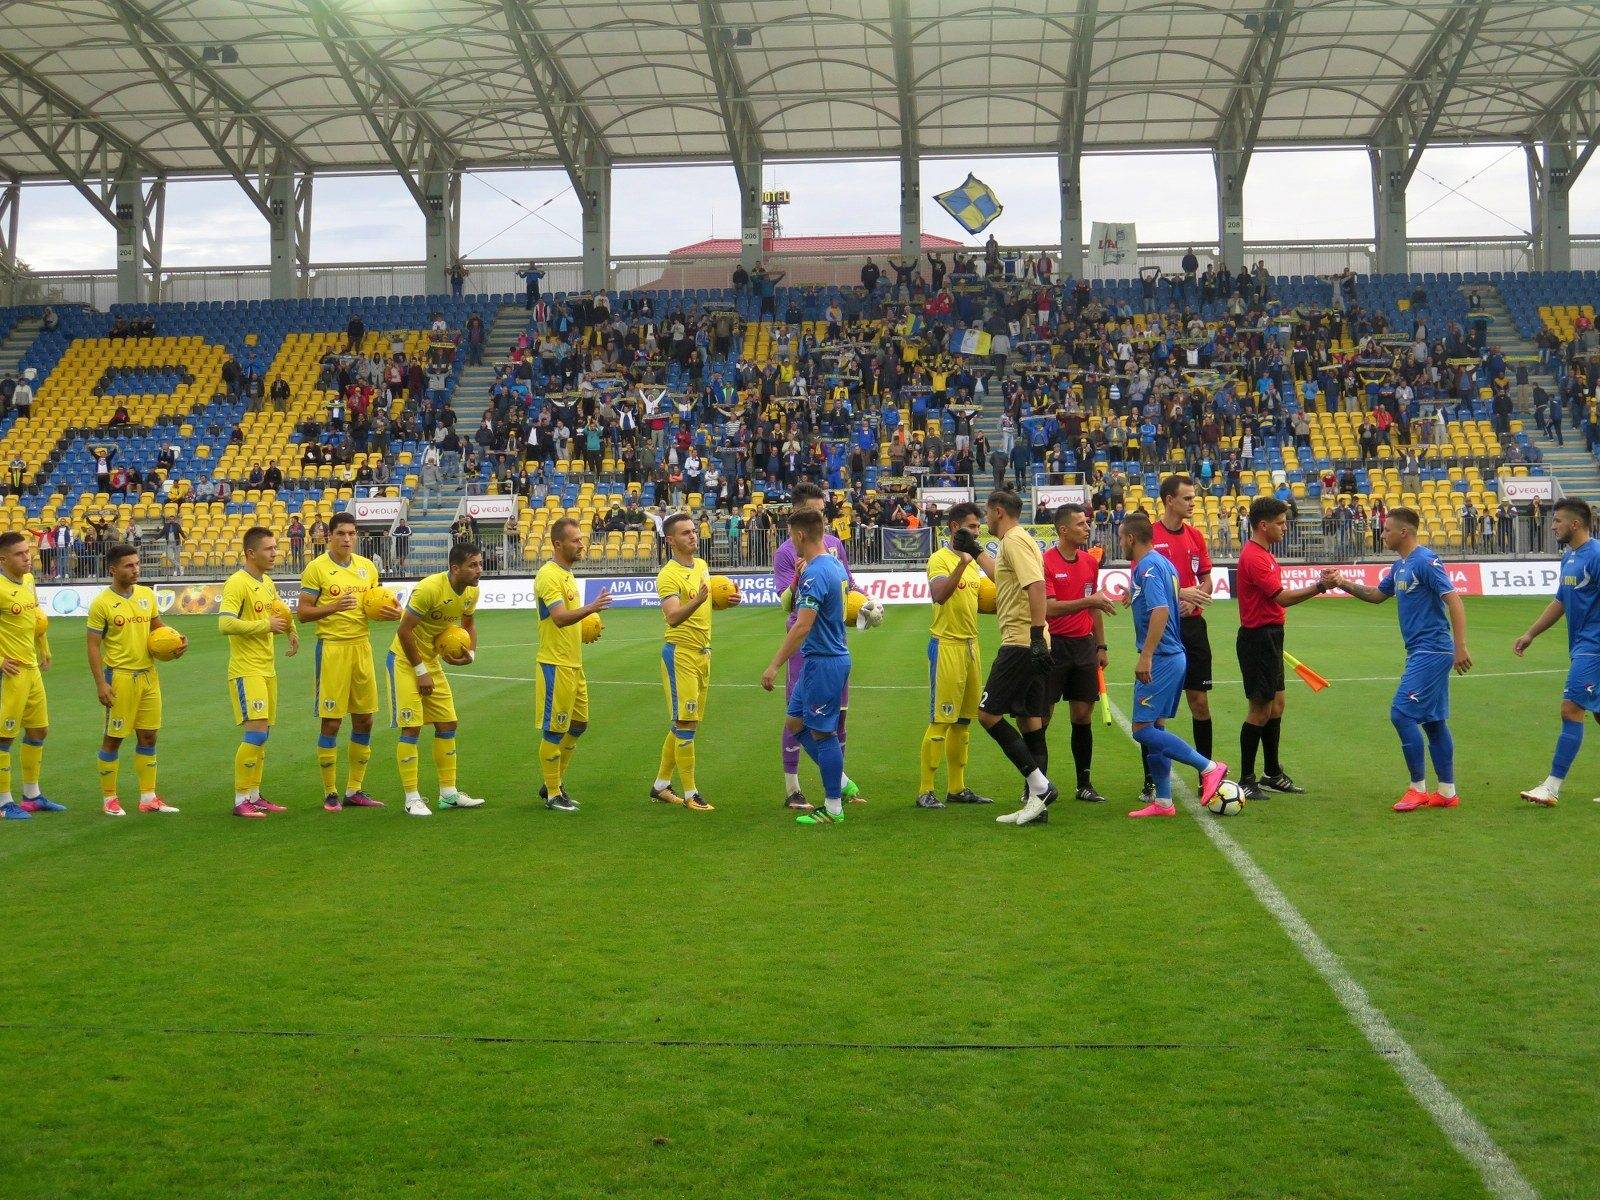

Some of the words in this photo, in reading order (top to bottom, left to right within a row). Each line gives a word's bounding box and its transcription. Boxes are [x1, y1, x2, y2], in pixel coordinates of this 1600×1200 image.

[370, 507, 400, 515] VEOLIA
[481, 506, 511, 514] VEOLIA
[1490, 570, 1536, 588] Hai
[610, 581, 632, 593] APA
[483, 592, 506, 603] se
